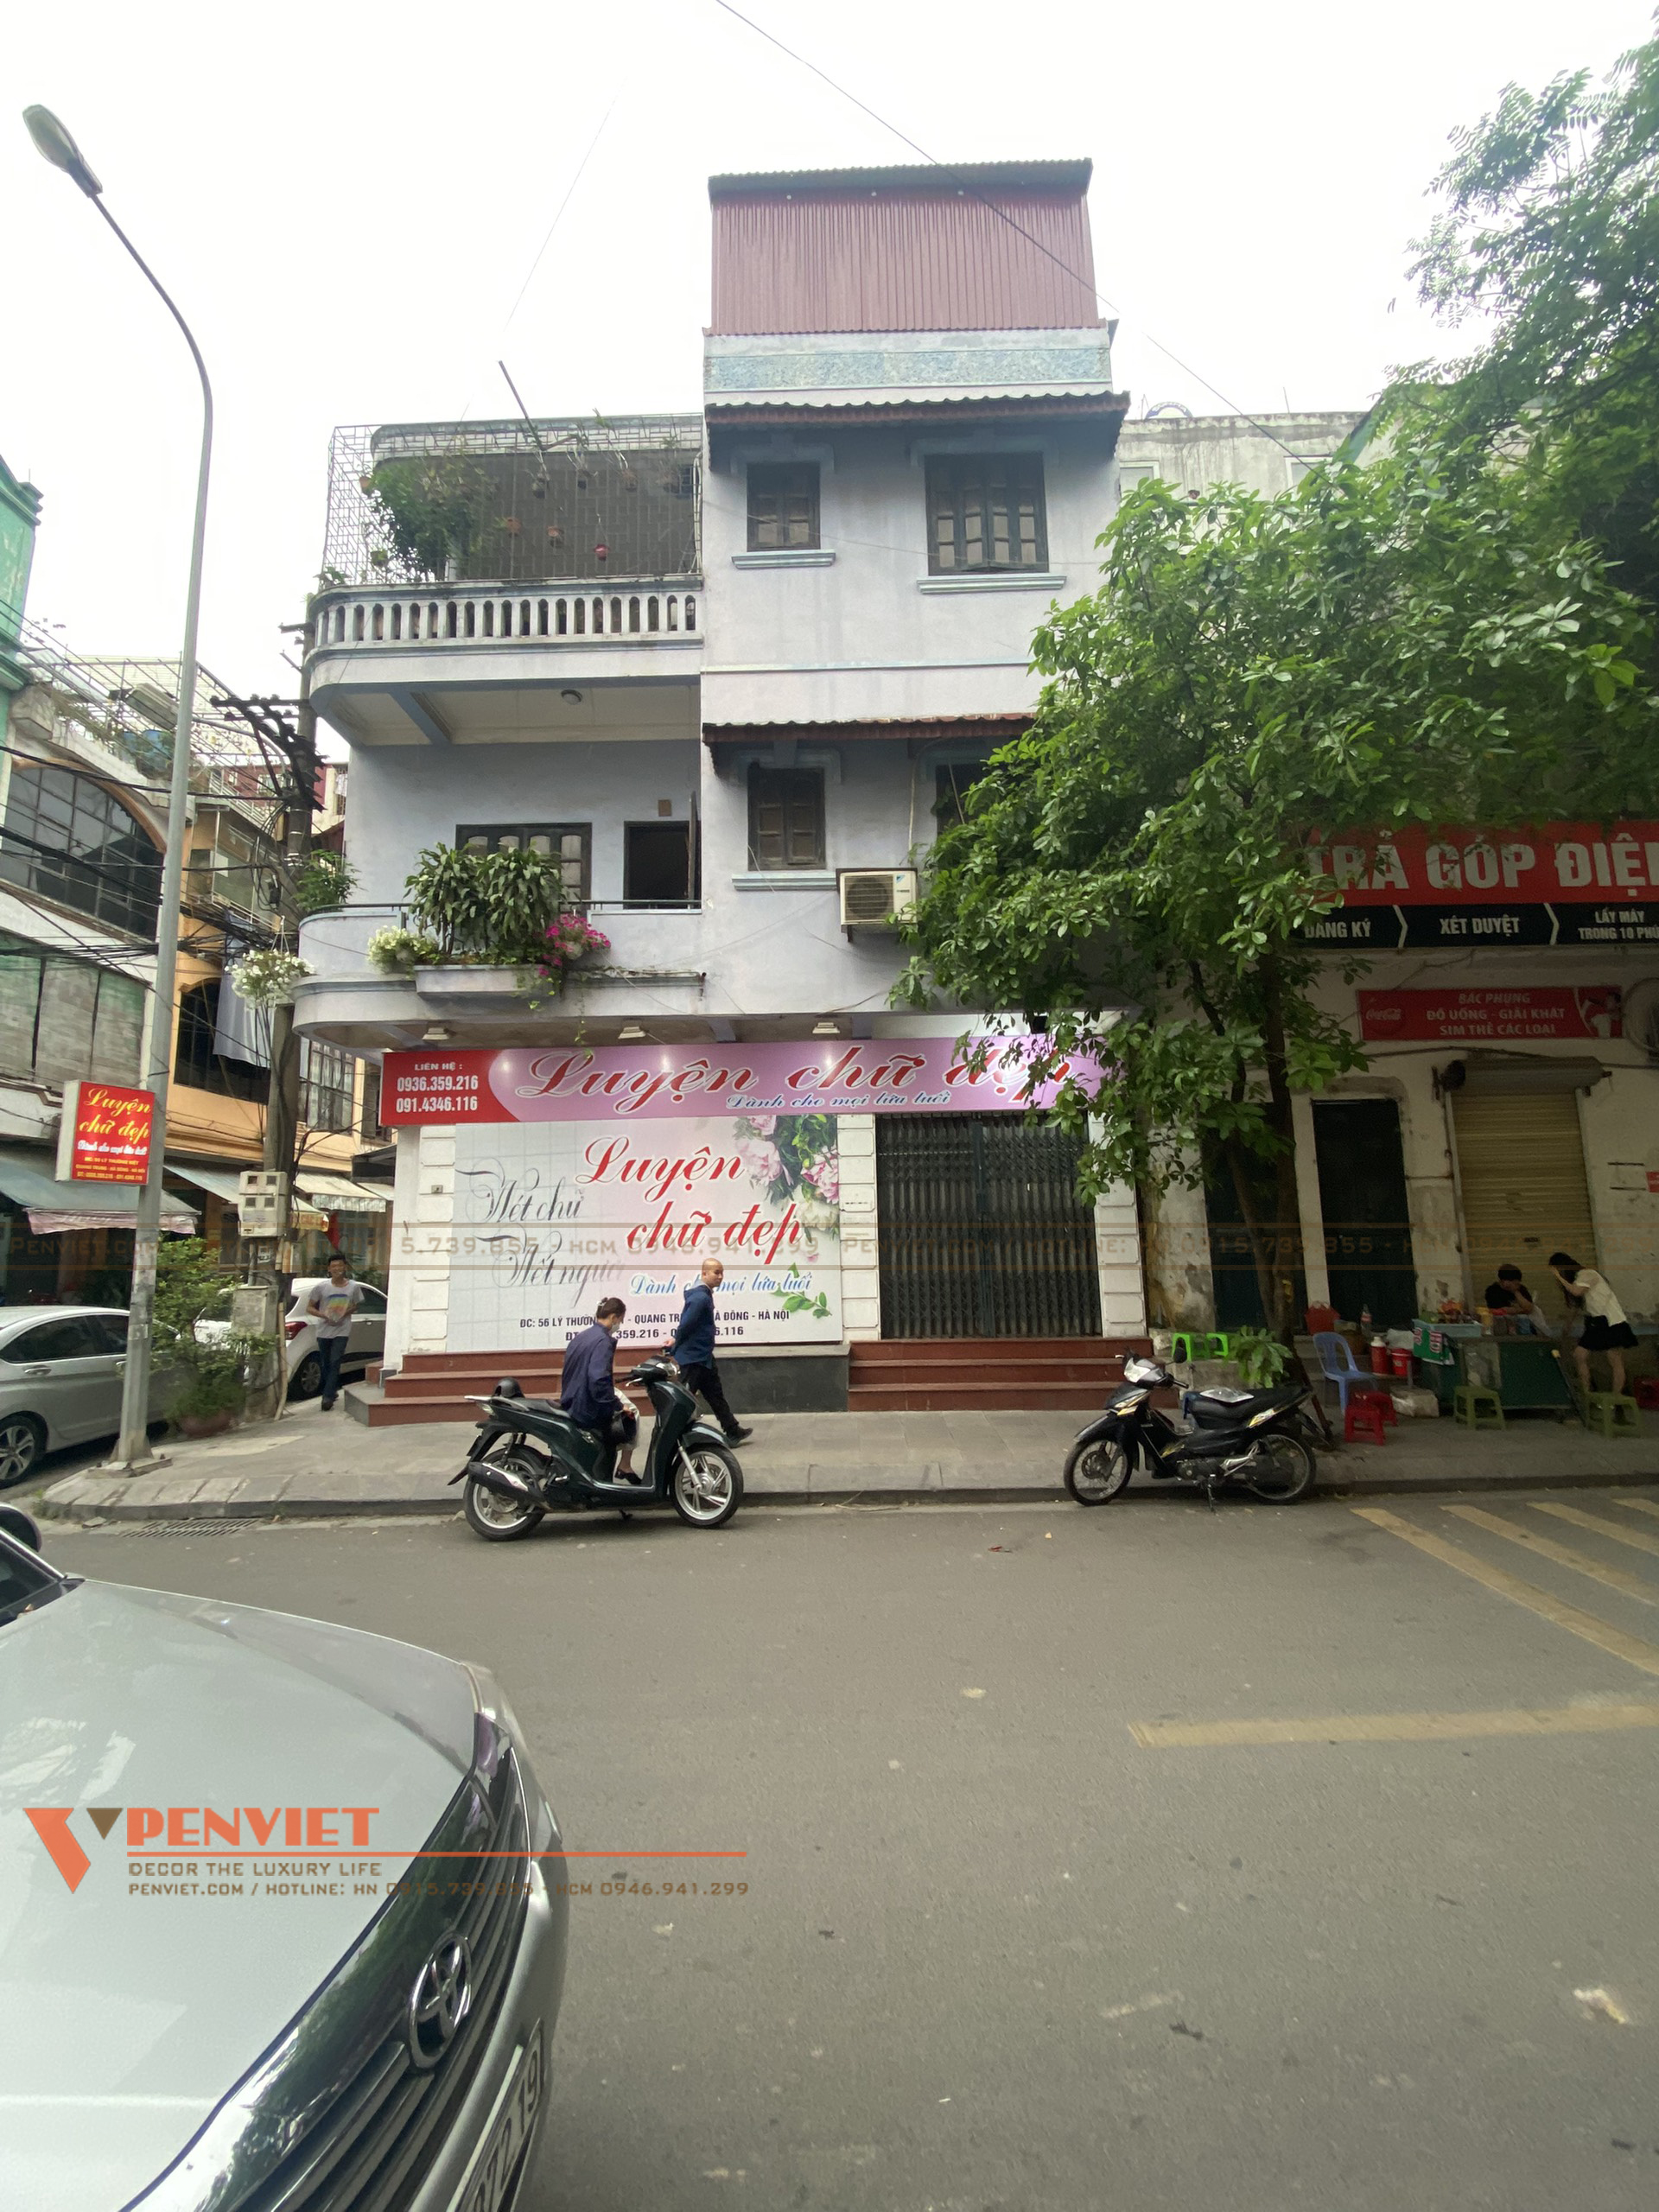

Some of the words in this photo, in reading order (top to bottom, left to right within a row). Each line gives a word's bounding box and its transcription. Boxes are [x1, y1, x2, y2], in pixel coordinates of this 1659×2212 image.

[1351, 918, 1371, 938] KÝ
[1472, 914, 1519, 938] DUYỆT
[1578, 927, 1617, 940] TRONG
[1620, 927, 1634, 940] 10
[1440, 1024, 1465, 1036] SIM
[397, 1075, 479, 1092] 0936.359.216
[517, 1051, 759, 1114] Luyện
[787, 1046, 926, 1090] chữ
[83, 1088, 151, 1117] Luyện
[396, 1096, 478, 1113] 091.4346.116
[728, 1094, 783, 1109] Dành
[791, 1092, 825, 1107] cho
[830, 1094, 869, 1109] mọi
[79, 1114, 116, 1135] chữ
[118, 1120, 149, 1145] đẹp
[575, 1136, 746, 1203] Luyện
[626, 1201, 712, 1249] chữ
[723, 1203, 804, 1265] đẹp
[630, 1274, 677, 1294] Dành
[751, 1272, 777, 1293] lứa
[782, 1272, 812, 1293] tuổi
[520, 1319, 536, 1328] ĐC:
[537, 1318, 550, 1328] 56
[566, 1314, 596, 1326] THƯỜN
[634, 1314, 666, 1324] QUANG
[723, 1310, 749, 1321] ĐÔNG
[758, 1309, 771, 1320] HÀ
[772, 1309, 790, 1322] NỘI
